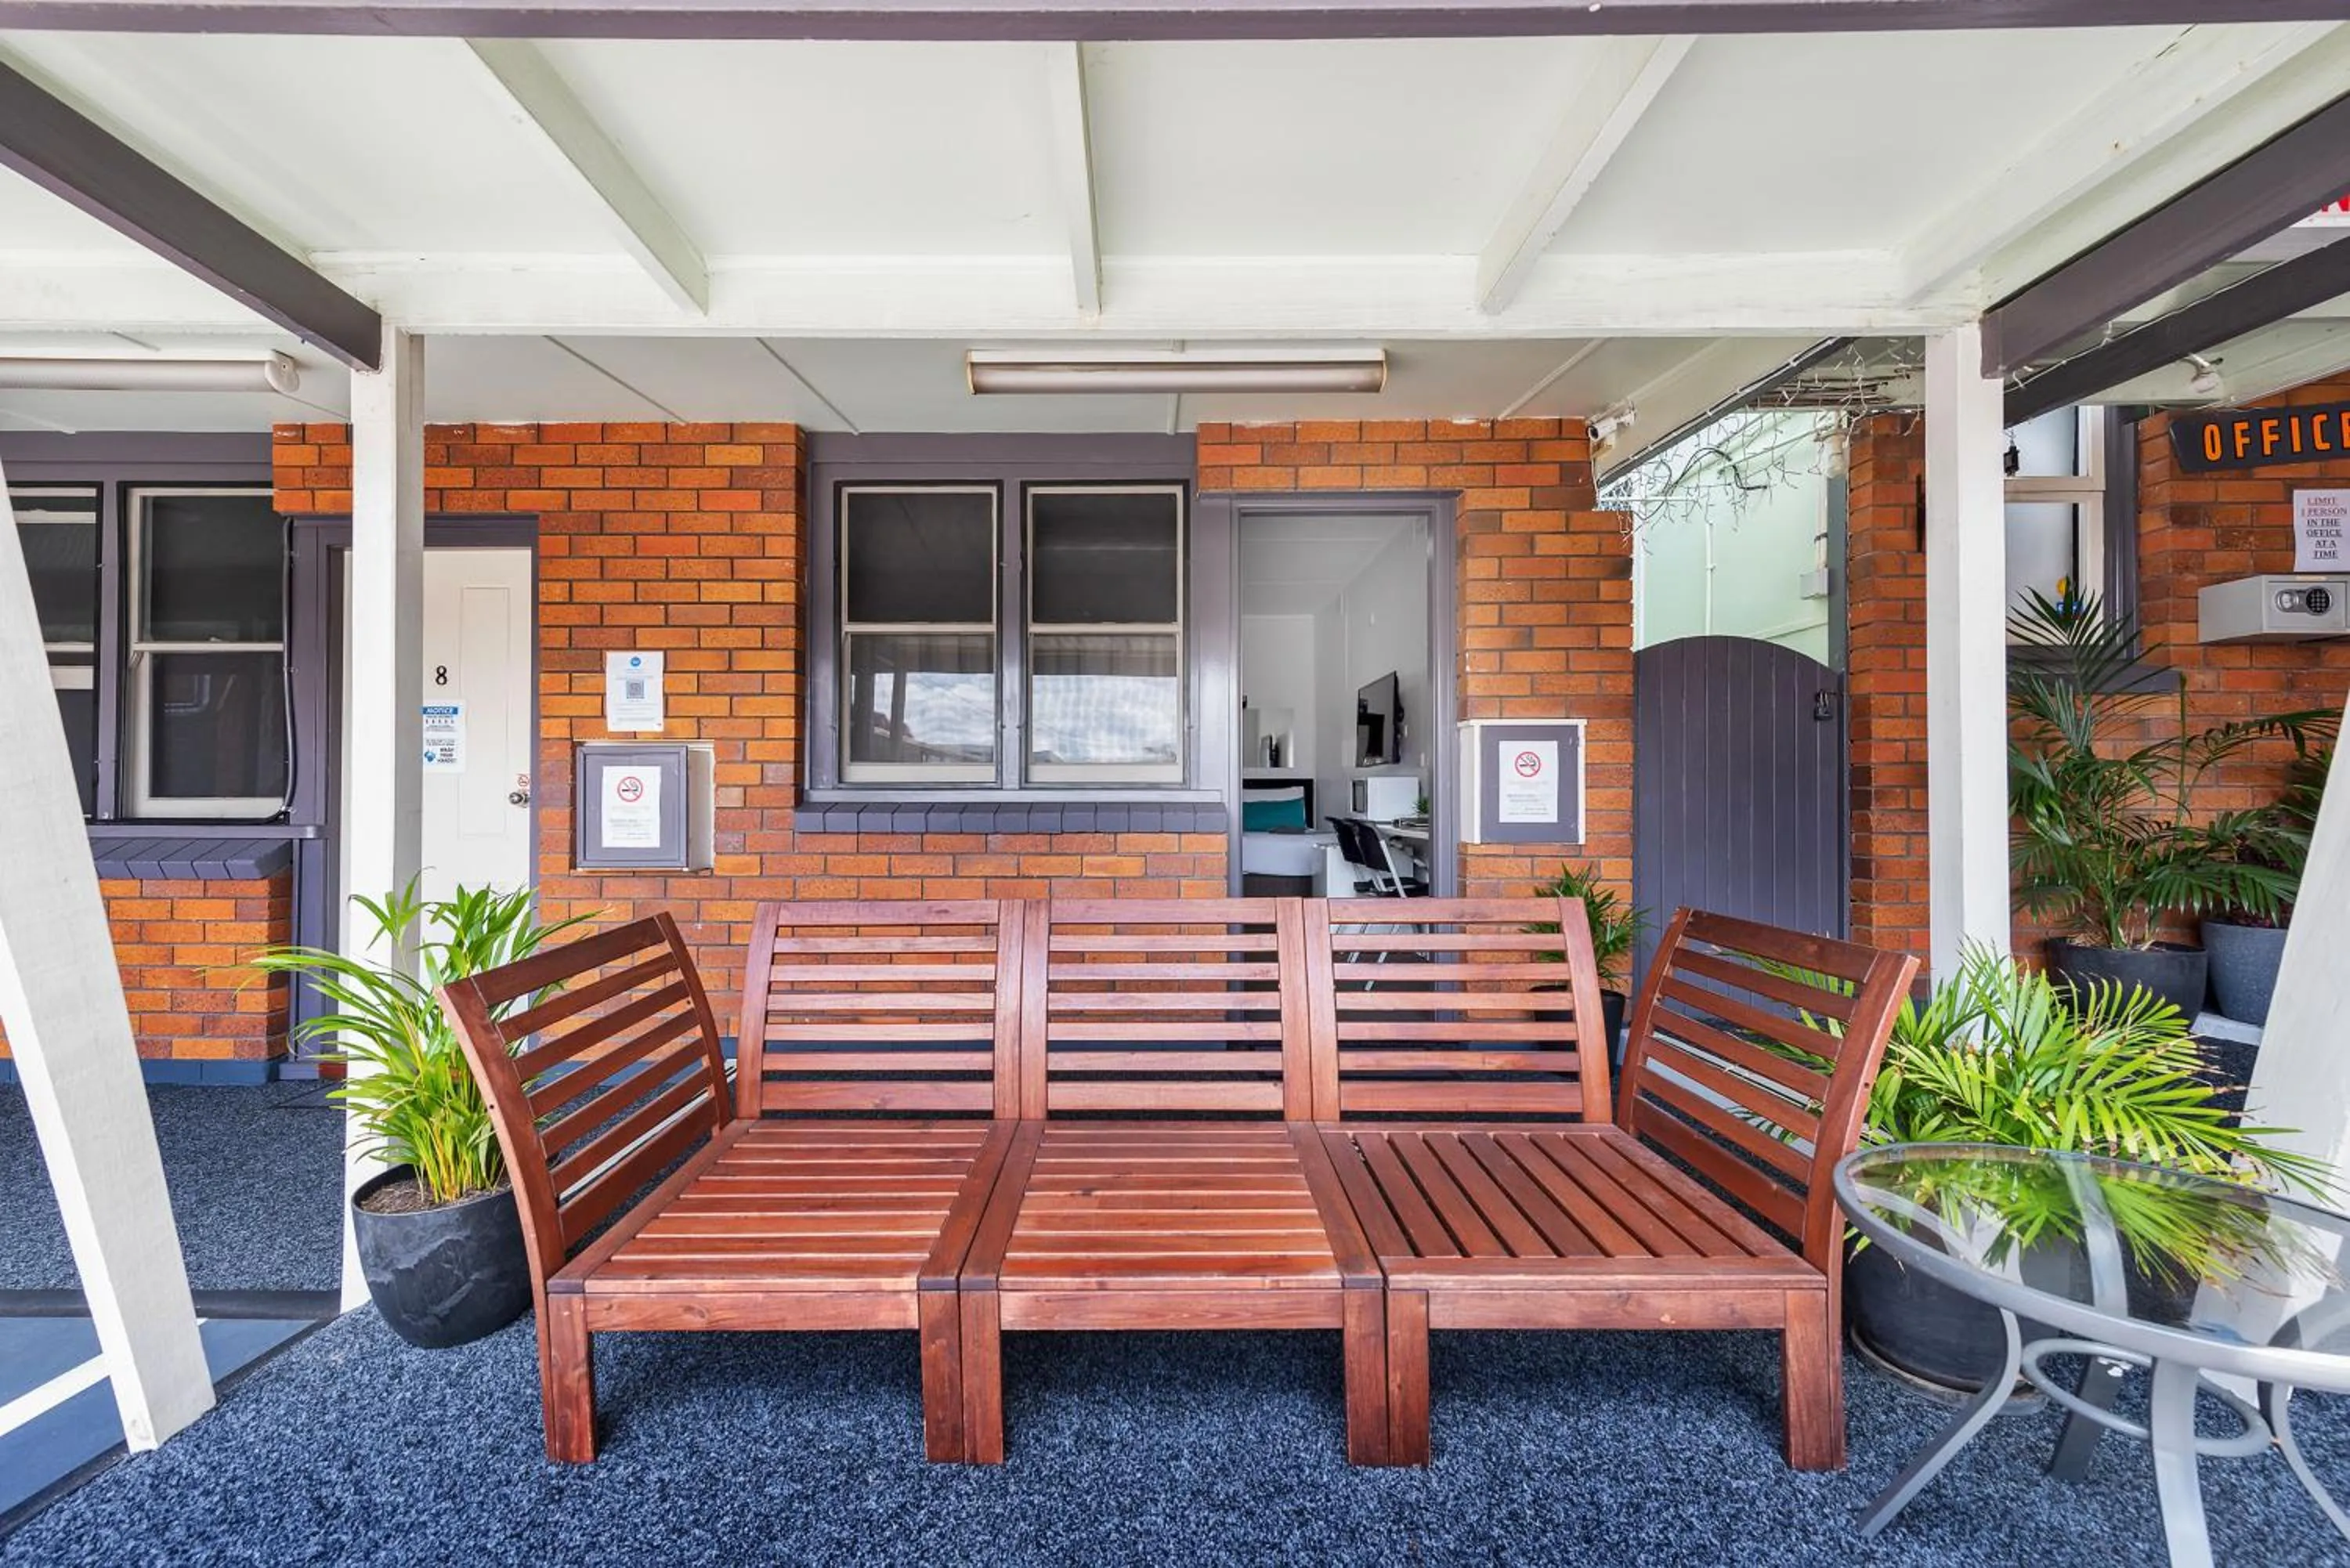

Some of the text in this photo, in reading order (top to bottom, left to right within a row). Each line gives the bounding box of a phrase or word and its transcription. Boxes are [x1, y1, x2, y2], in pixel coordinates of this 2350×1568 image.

[2203, 411, 2350, 461] OFFICE
[2307, 497, 2335, 506] LIMIT
[2307, 507, 2348, 517] PERSON
[2307, 518, 2341, 527] IN THE
[2305, 529, 2343, 537] OFFICE
[2315, 540, 2337, 548] AT A
[2314, 550, 2338, 559] TIME
[435, 665, 448, 686] 8
